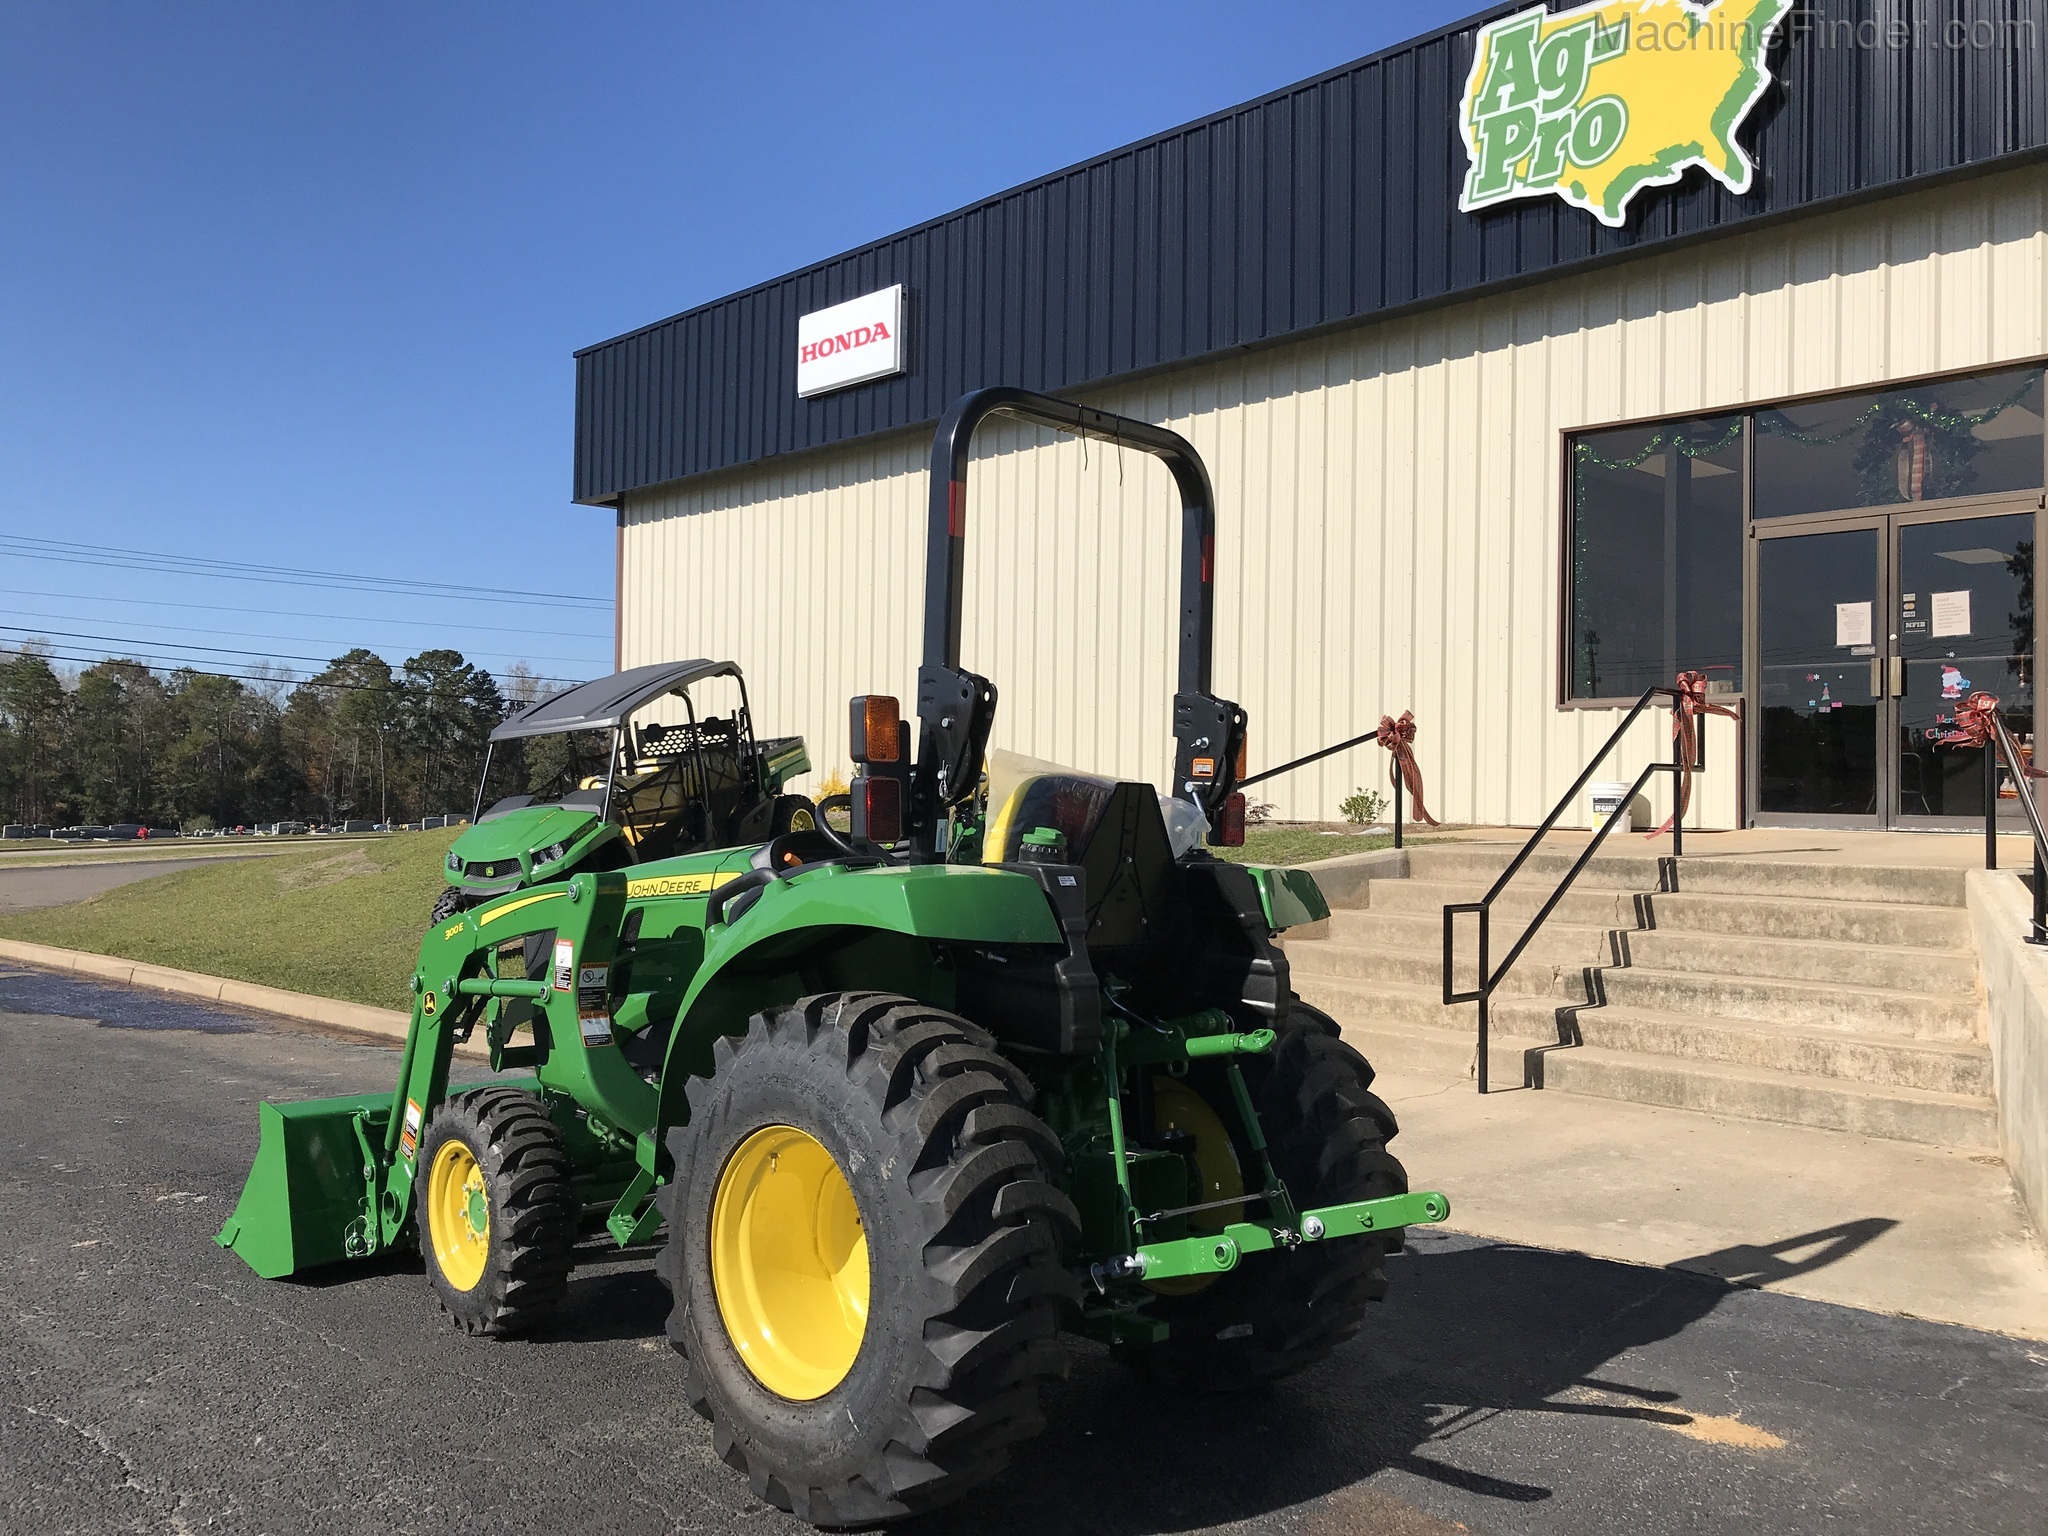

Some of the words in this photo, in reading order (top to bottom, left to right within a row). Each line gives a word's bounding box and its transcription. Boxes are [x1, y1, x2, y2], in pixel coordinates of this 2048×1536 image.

[1471, 96, 1627, 200] Pro
[801, 322, 891, 364] HONDA
[1925, 727, 1968, 739] Christ
[627, 883, 659, 896] JOHN
[659, 880, 701, 893] DEERE
